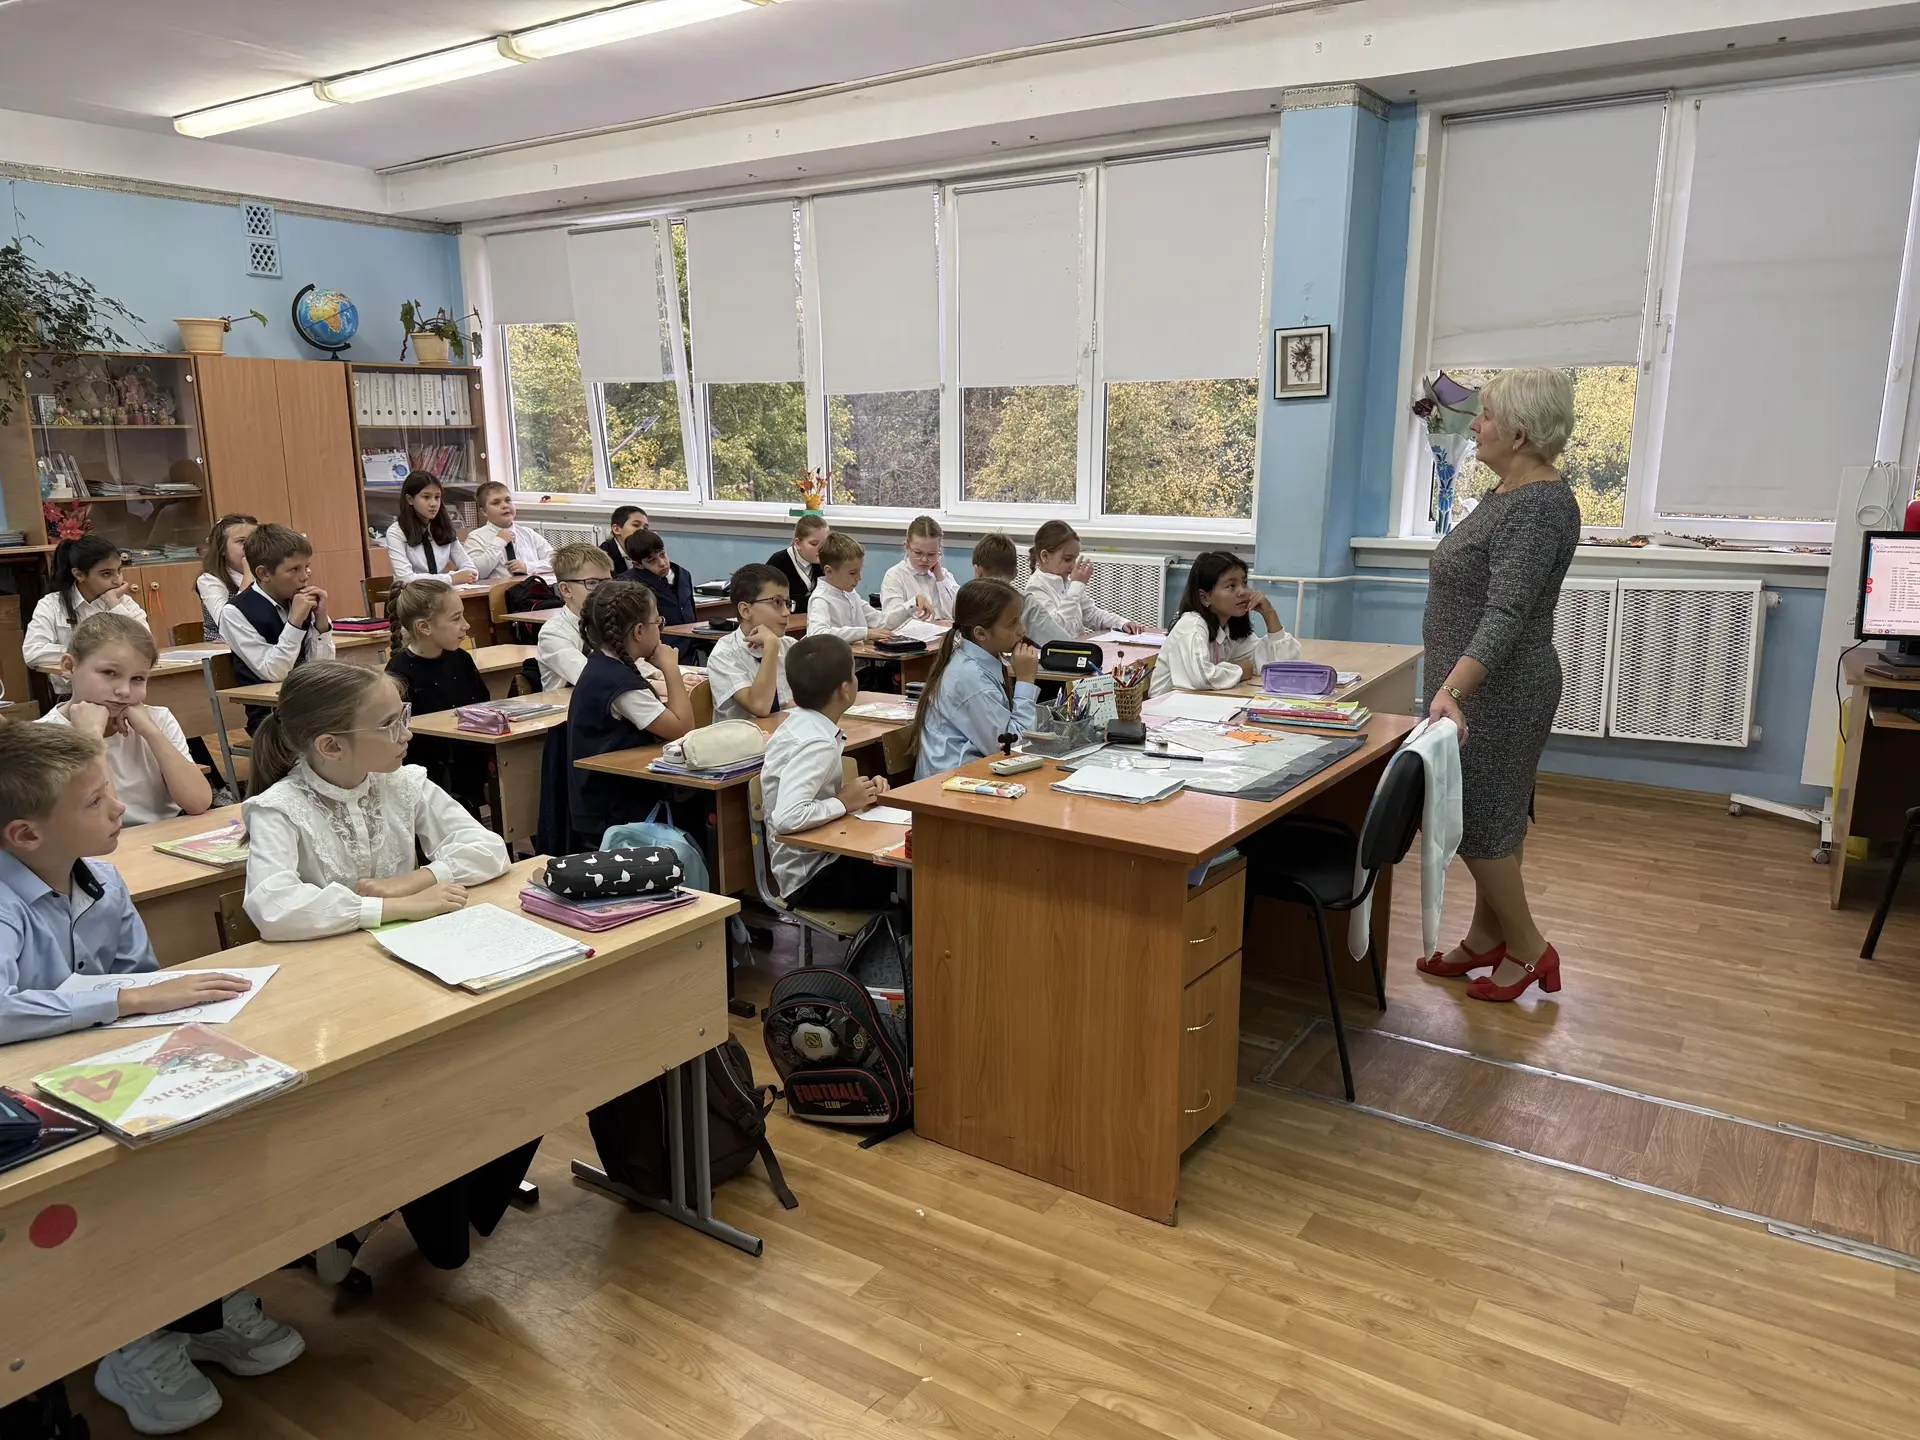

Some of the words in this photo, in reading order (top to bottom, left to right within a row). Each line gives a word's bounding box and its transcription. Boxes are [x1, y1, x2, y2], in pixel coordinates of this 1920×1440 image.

[60, 1068, 124, 1103] 4
[792, 1081, 869, 1104] FOOTBALL
[825, 1101, 841, 1109] CLUB
